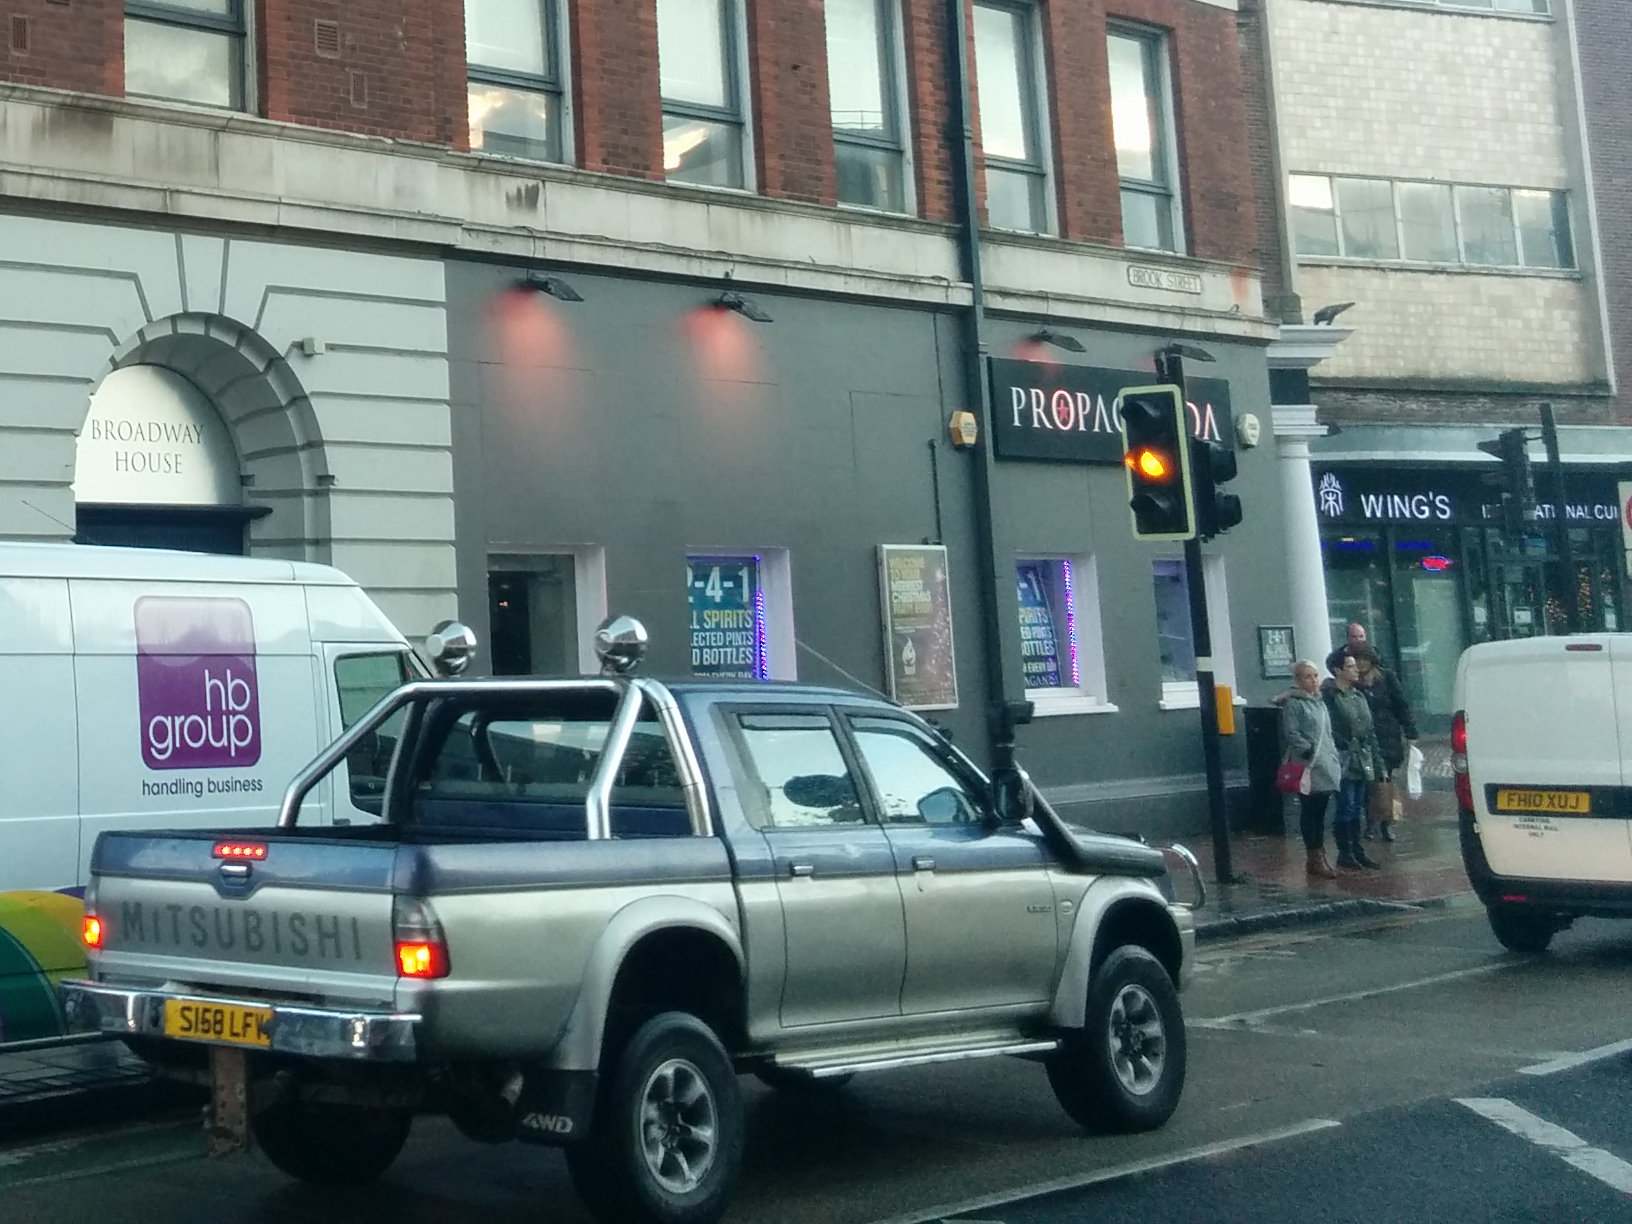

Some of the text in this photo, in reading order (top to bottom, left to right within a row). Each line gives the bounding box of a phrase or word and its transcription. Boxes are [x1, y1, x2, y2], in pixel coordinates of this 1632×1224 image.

[1167, 274, 1198, 291] STREET
[91, 419, 204, 445] BROADWAY
[115, 451, 183, 474] HOUSE
[1361, 491, 1450, 519] WING'S
[703, 609, 753, 629] SPIRITS
[725, 631, 754, 646] PINTS
[702, 647, 754, 665] BOTTLES
[204, 668, 250, 711] hb
[148, 711, 253, 761] group
[141, 777, 264, 799] handling business
[121, 900, 363, 960] MITSUBISHI
[522, 1112, 573, 1133] 4WD
